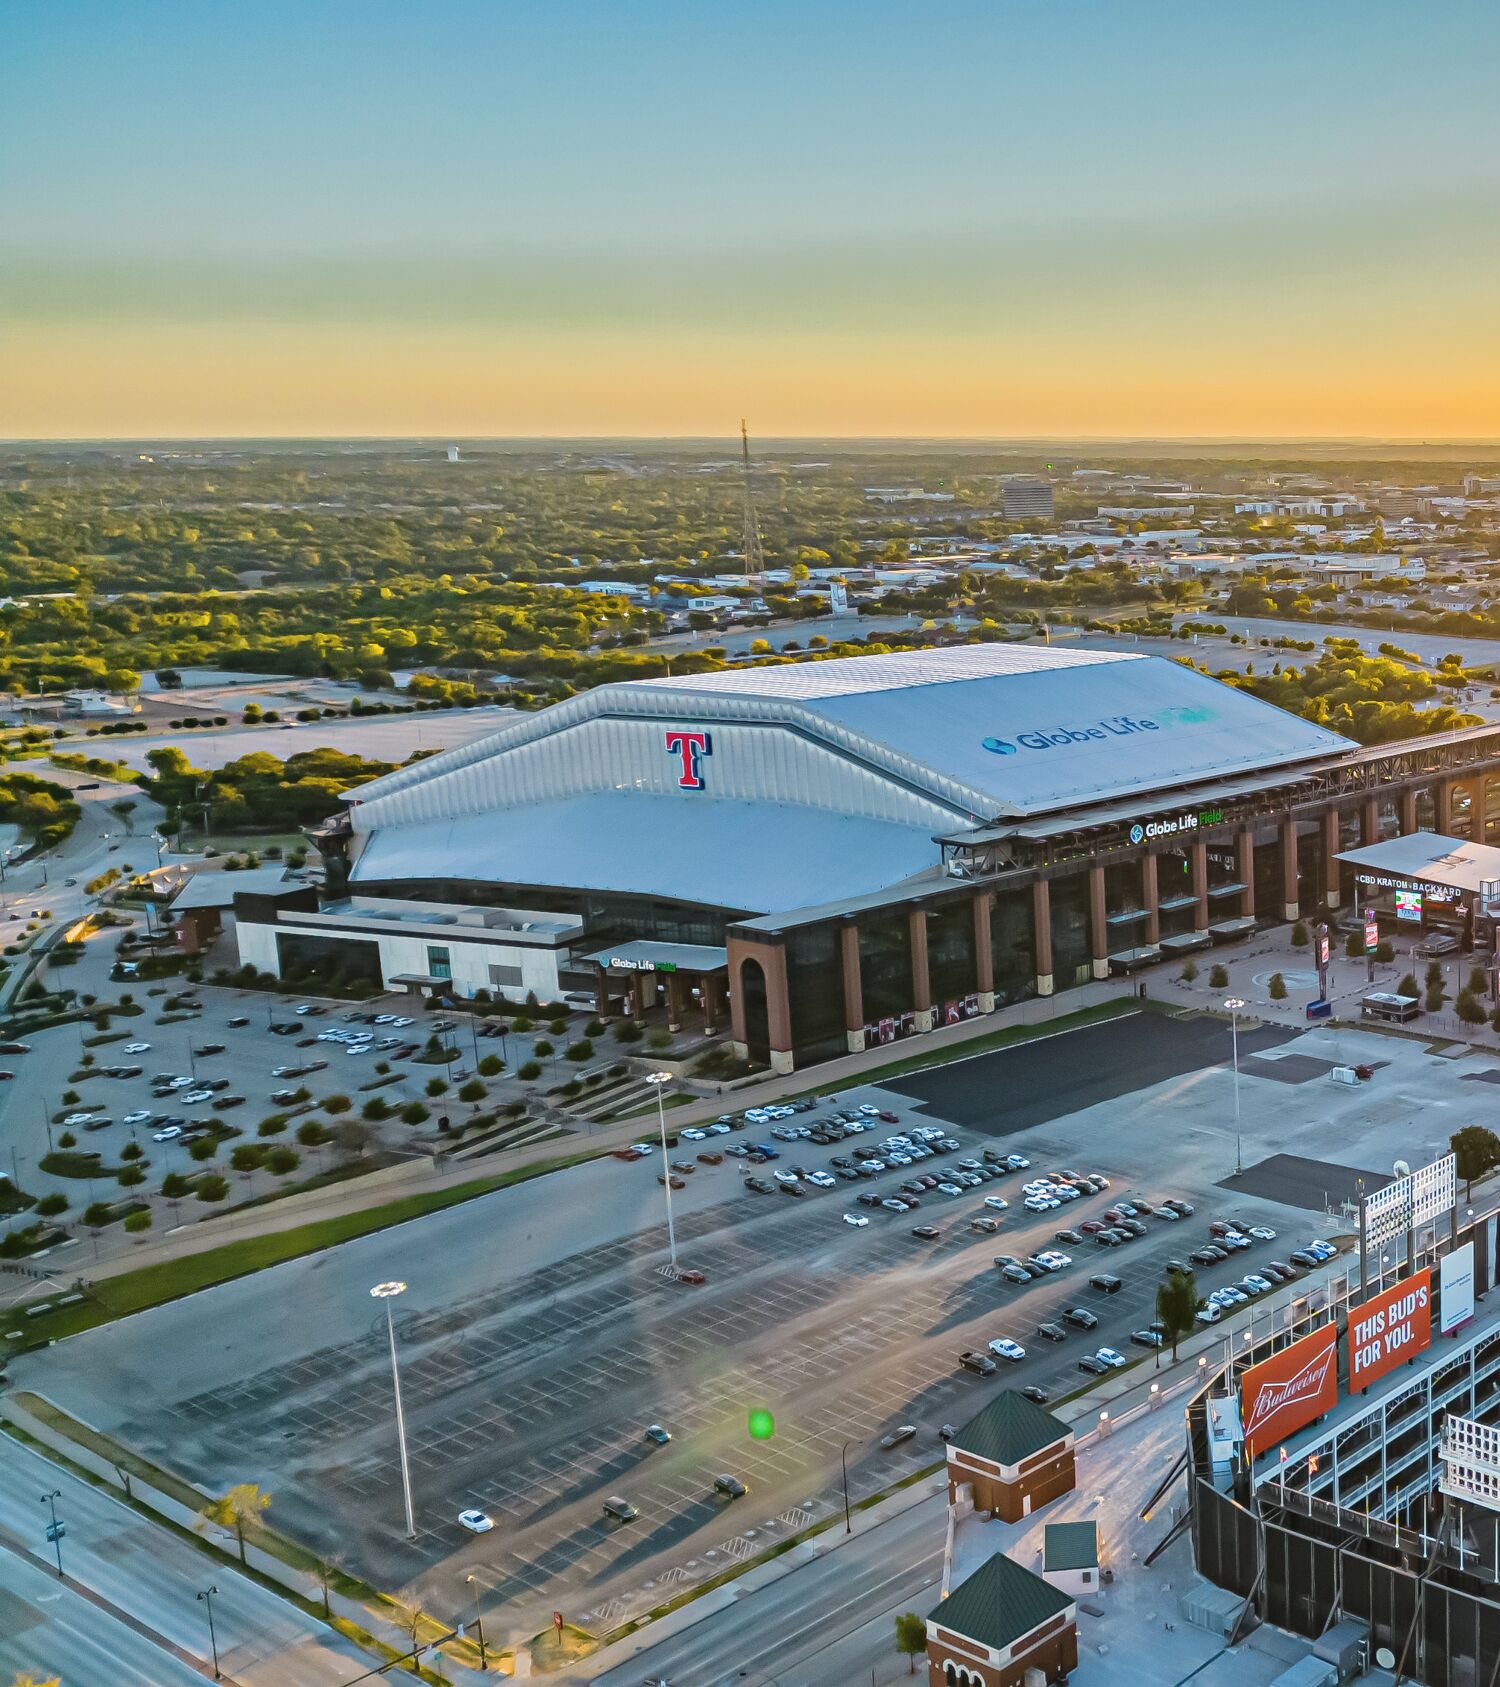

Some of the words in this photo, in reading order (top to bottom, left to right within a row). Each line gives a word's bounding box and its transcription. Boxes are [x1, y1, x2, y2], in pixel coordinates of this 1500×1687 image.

[1016, 727, 1107, 750] Globe
[1100, 716, 1160, 736] Life
[665, 731, 711, 789] T
[1145, 820, 1178, 837] Globe
[1179, 814, 1198, 830] Life
[1199, 808, 1222, 825] Field
[1359, 874, 1376, 885] CBD
[1376, 878, 1408, 889] KRATOM
[1412, 882, 1462, 897] BACKYARD
[611, 957, 637, 969] Globe
[638, 960, 655, 971] Life
[1354, 1310, 1385, 1347] THIS
[1388, 1285, 1428, 1326] BUD'S
[1354, 1341, 1382, 1374] FOR
[1384, 1320, 1415, 1354] YOU.
[1253, 1365, 1327, 1418] Budweiser
